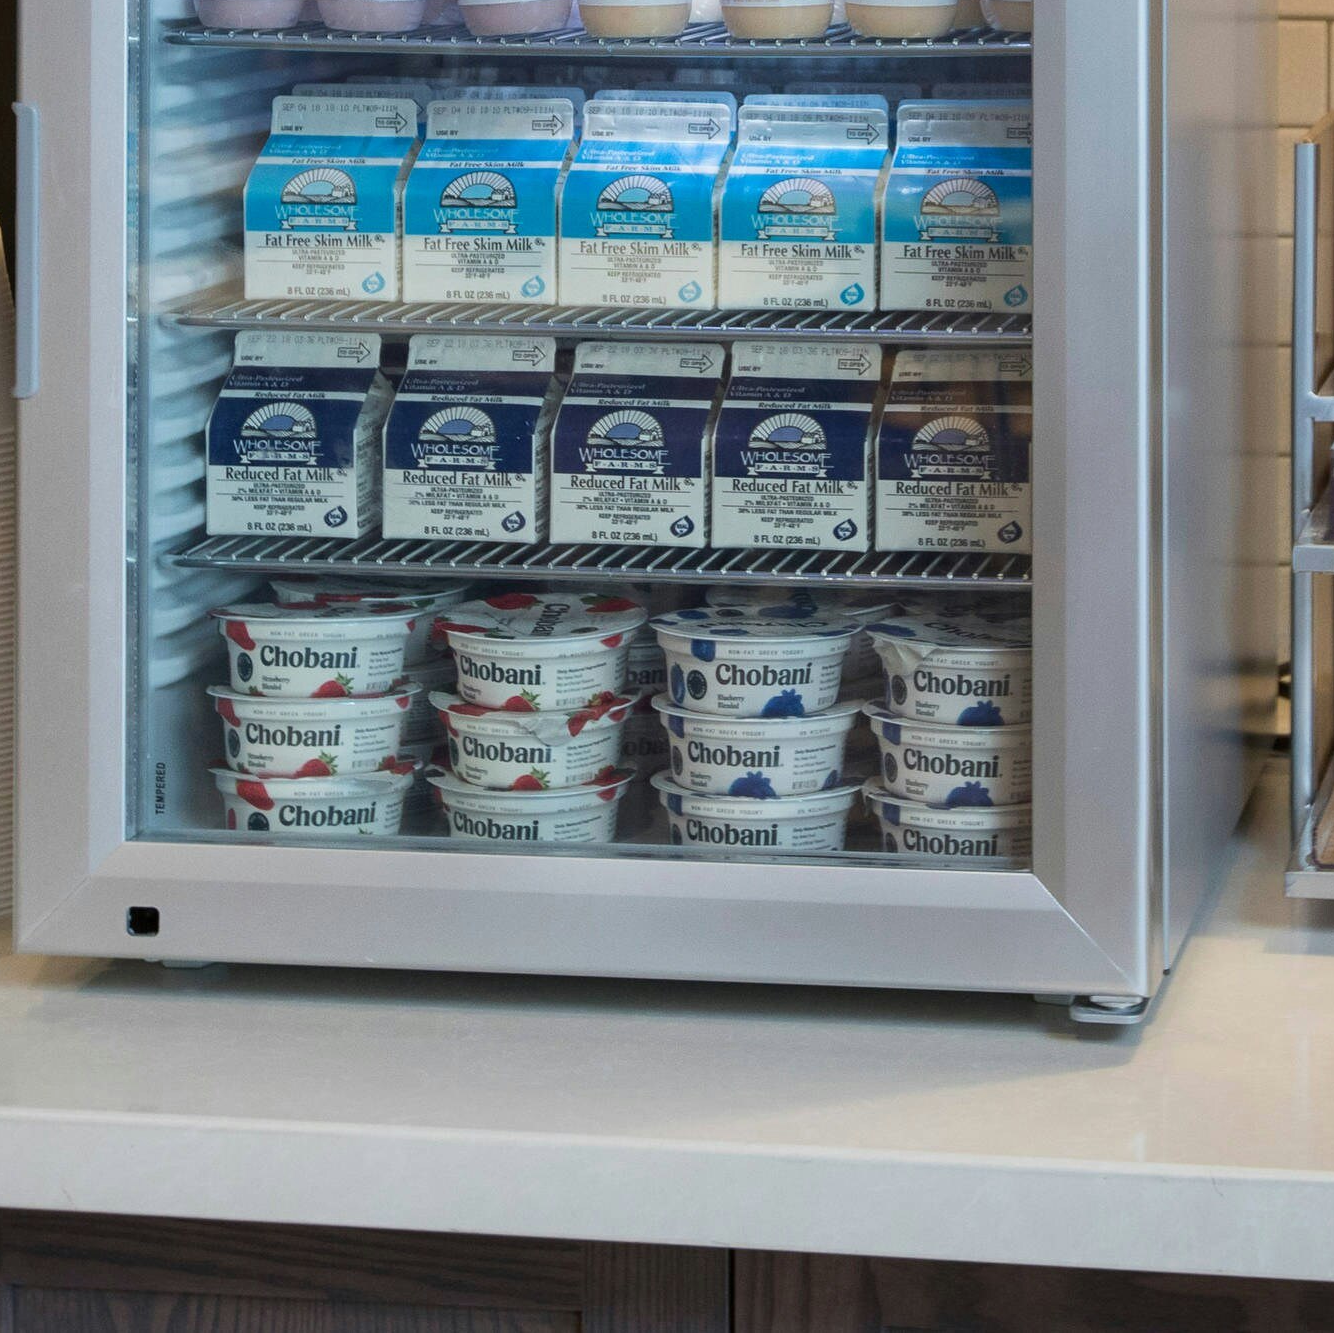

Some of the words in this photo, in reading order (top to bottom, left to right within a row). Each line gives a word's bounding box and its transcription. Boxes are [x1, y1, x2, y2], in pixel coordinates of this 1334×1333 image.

[275, 205, 362, 221] WHOLESOME
[434, 209, 523, 224] WHOLESOME
[590, 213, 679, 228] WHOLESOME
[751, 216, 843, 231] WHOLESOME
[913, 216, 1004, 231] WHOLESOME
[266, 235, 282, 247] Fat
[286, 235, 310, 247] Free
[314, 234, 342, 248] Skim
[346, 235, 373, 248] Milk
[424, 238, 440, 251] Fat
[444, 239, 470, 251] Free
[474, 239, 502, 251] Skim
[505, 239, 532, 251] Milk
[580, 242, 597, 254] Fat
[601, 243, 626, 254] Free
[630, 242, 659, 255] Skim
[662, 243, 689, 256] Milk
[741, 245, 759, 257] Fat
[763, 245, 788, 258] Free
[791, 245, 821, 258] Skim
[824, 245, 852, 259] Milk
[904, 246, 921, 258] Fat
[925, 247, 950, 259] Free
[955, 246, 983, 259] Skim
[987, 247, 1016, 260] Milk
[771, 298, 779, 306] FL
[781, 298, 792, 306] OZ
[794, 298, 809, 308] (236
[811, 298, 828, 308] mL)
[233, 440, 324, 456] WHOLESOME
[411, 443, 500, 461] WHOLESOME
[579, 447, 671, 465] WHOLESOME
[740, 451, 835, 468] WHOLESOME
[904, 453, 996, 470] WHOLESOME
[226, 467, 281, 481] Reduced
[285, 468, 302, 481] Fat
[306, 468, 334, 482] Milk
[403, 471, 458, 485] Reduced
[461, 472, 480, 486] Fat
[484, 472, 512, 487] Milk
[570, 475, 625, 489] Reduced
[629, 476, 648, 490] Fat
[651, 476, 681, 491] Milk
[732, 478, 787, 492] Reduced
[791, 479, 810, 493] Fat
[814, 479, 843, 494] Milk
[896, 481, 949, 495] Reduced
[953, 482, 973, 496] Fat
[976, 482, 1008, 496] Milk
[260, 645, 358, 669] Chobani
[460, 653, 542, 686] Chobani
[715, 662, 813, 687] Chobani
[914, 669, 1010, 697] Chobani
[246, 724, 342, 748] Chobani
[462, 735, 553, 765] Chobani
[687, 741, 780, 769] Chobani
[903, 748, 1000, 779] Chobani
[156, 762, 166, 815] TEMPERED
[278, 801, 376, 827] Chobani
[453, 810, 539, 841] Chobani
[686, 819, 778, 846] Chobani
[903, 828, 998, 856] Chobani
